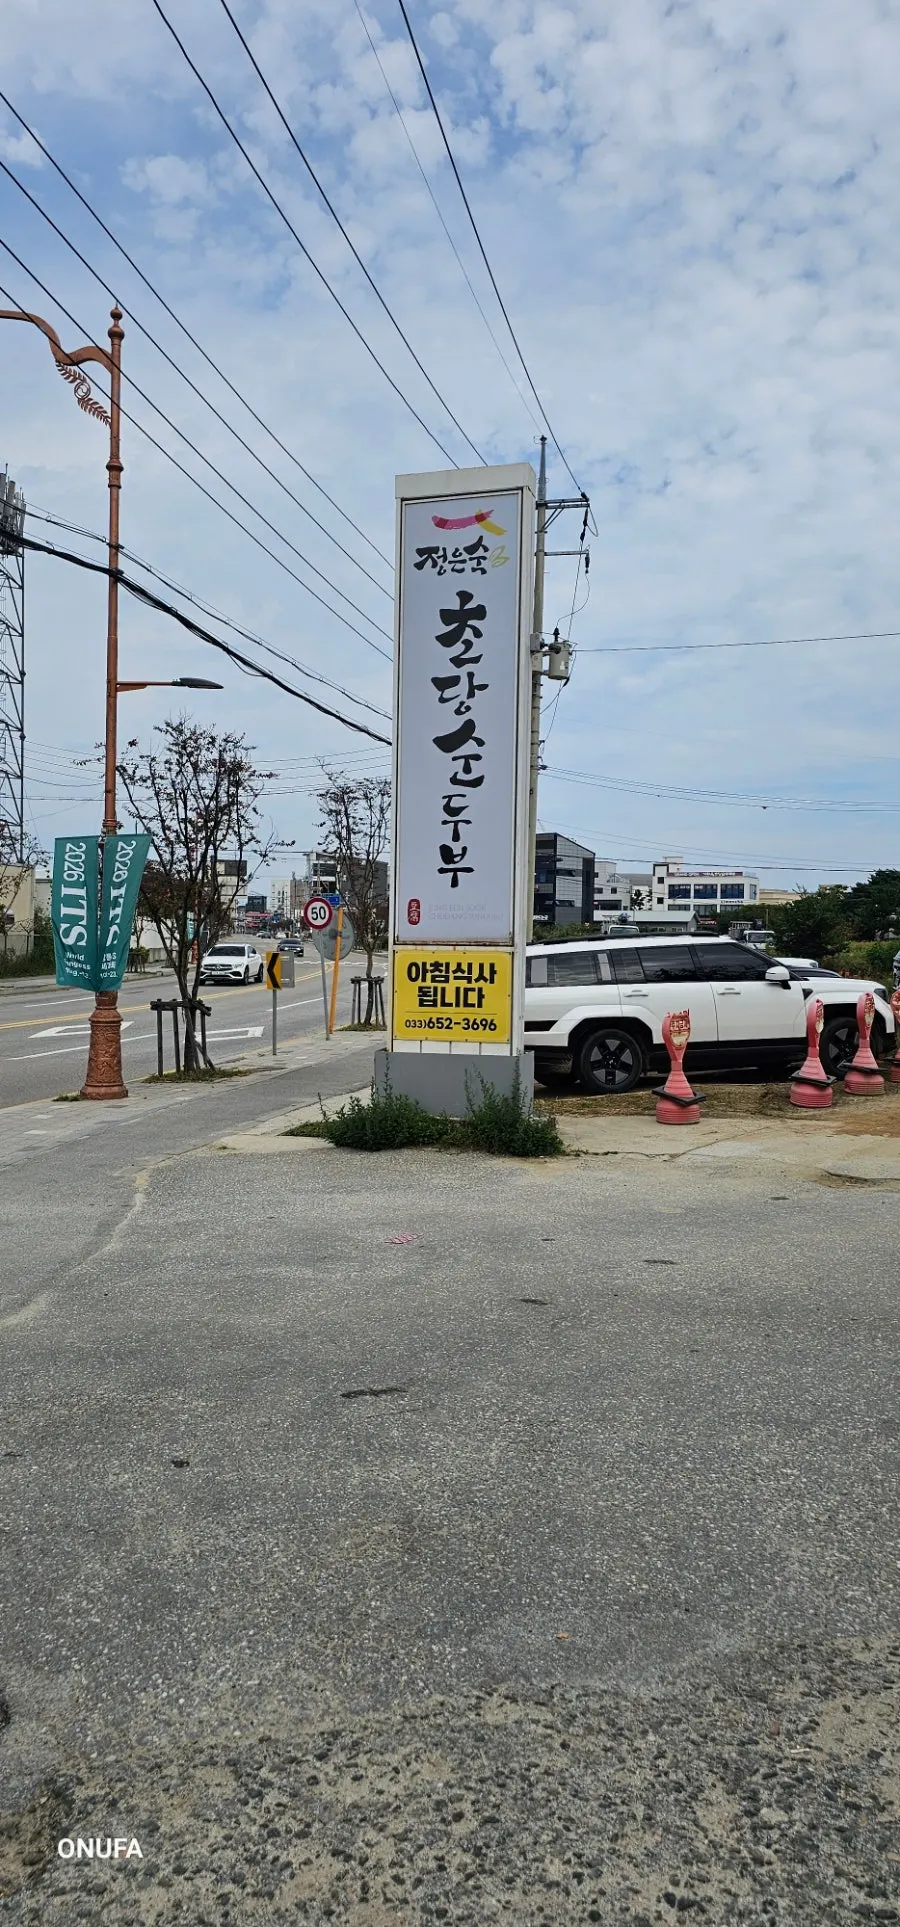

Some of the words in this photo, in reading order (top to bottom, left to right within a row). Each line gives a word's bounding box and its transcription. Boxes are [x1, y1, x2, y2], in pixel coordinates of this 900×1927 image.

[413, 535, 489, 576] 정은숙
[431, 590, 489, 888] 초당순두부
[63, 842, 87, 882] 2026
[59, 884, 88, 946] ITS
[311, 906, 327, 921] 50
[407, 961, 498, 985] 아침식사
[417, 986, 486, 1009] 됩니다
[404, 1016, 497, 1032] 033)652-3696
